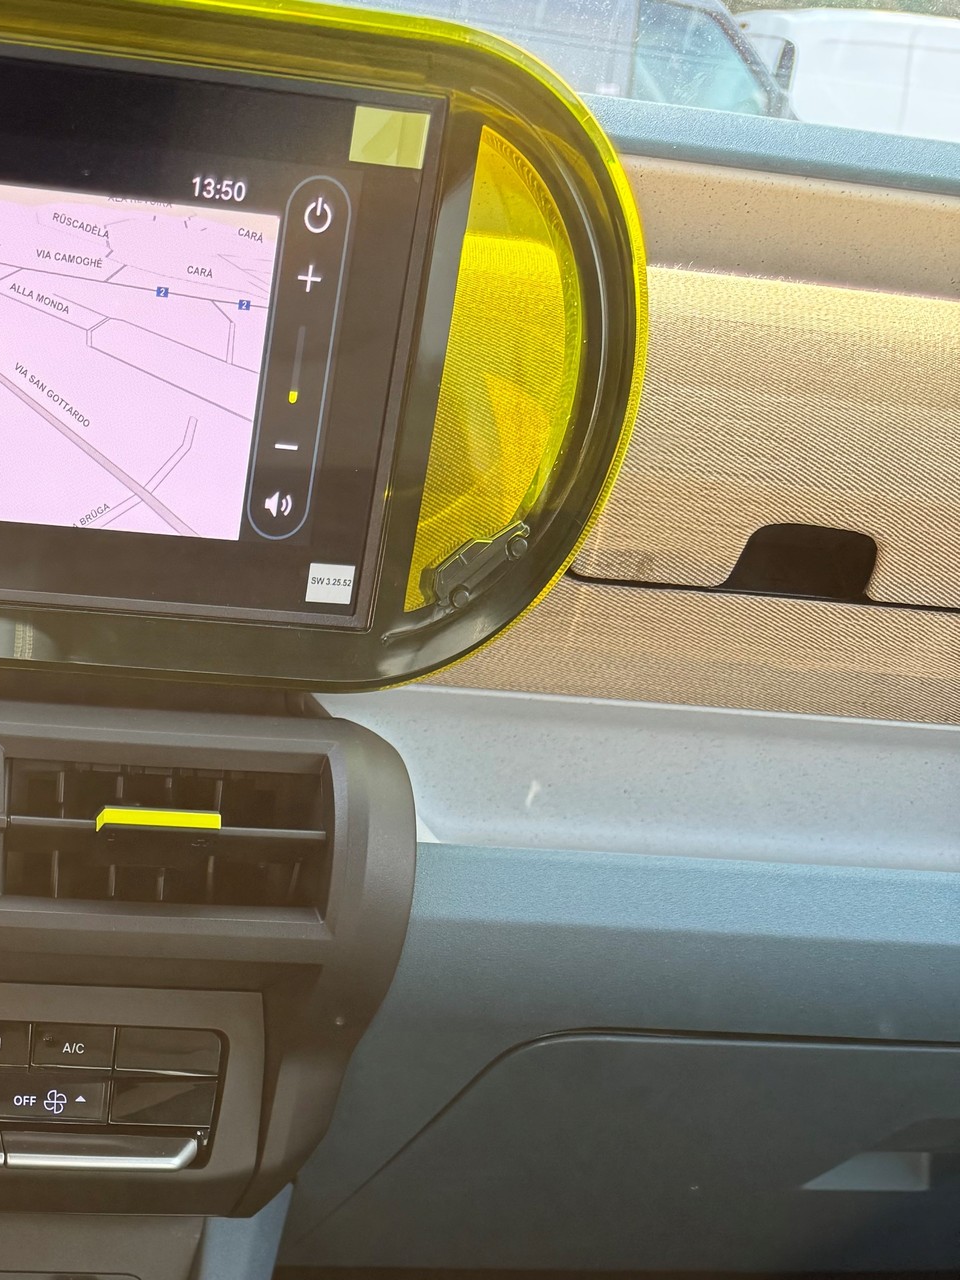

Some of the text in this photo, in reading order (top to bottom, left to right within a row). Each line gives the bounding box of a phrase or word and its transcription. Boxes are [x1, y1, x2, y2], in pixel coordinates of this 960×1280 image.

[191, 176, 246, 202] 13:50
[36, 248, 52, 260] VIA
[158, 287, 167, 297] 2
[9, 282, 70, 315] ALLA MONDA
[240, 300, 249, 310] 2
[14, 362, 91, 428] VIA SAN GOTTARDO
[310, 576, 325, 585] SW
[62, 1042, 85, 1055] A/C
[13, 1095, 37, 1107] OFF
